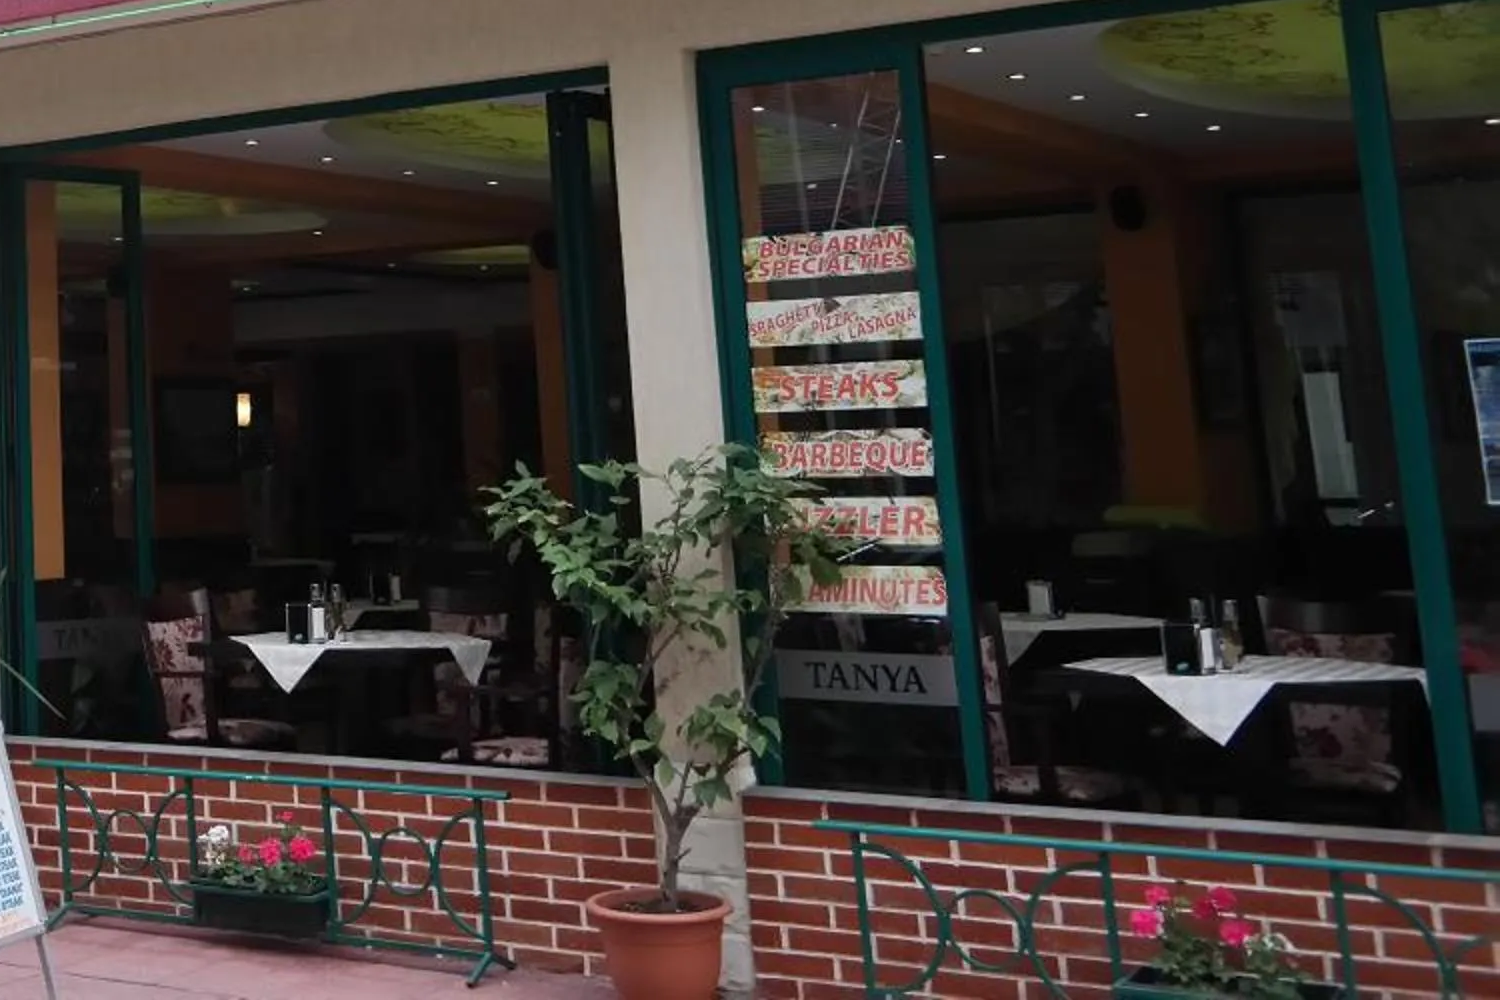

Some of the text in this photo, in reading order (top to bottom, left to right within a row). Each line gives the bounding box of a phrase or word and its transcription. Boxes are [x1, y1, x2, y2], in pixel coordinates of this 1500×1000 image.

[760, 231, 906, 258] BULGARIAN
[850, 307, 917, 339] LASAGNA
[779, 372, 900, 401] STEAKS
[772, 440, 926, 471] BARBEQUE
[800, 506, 926, 537] IZZLER
[804, 662, 928, 694] TANYA
